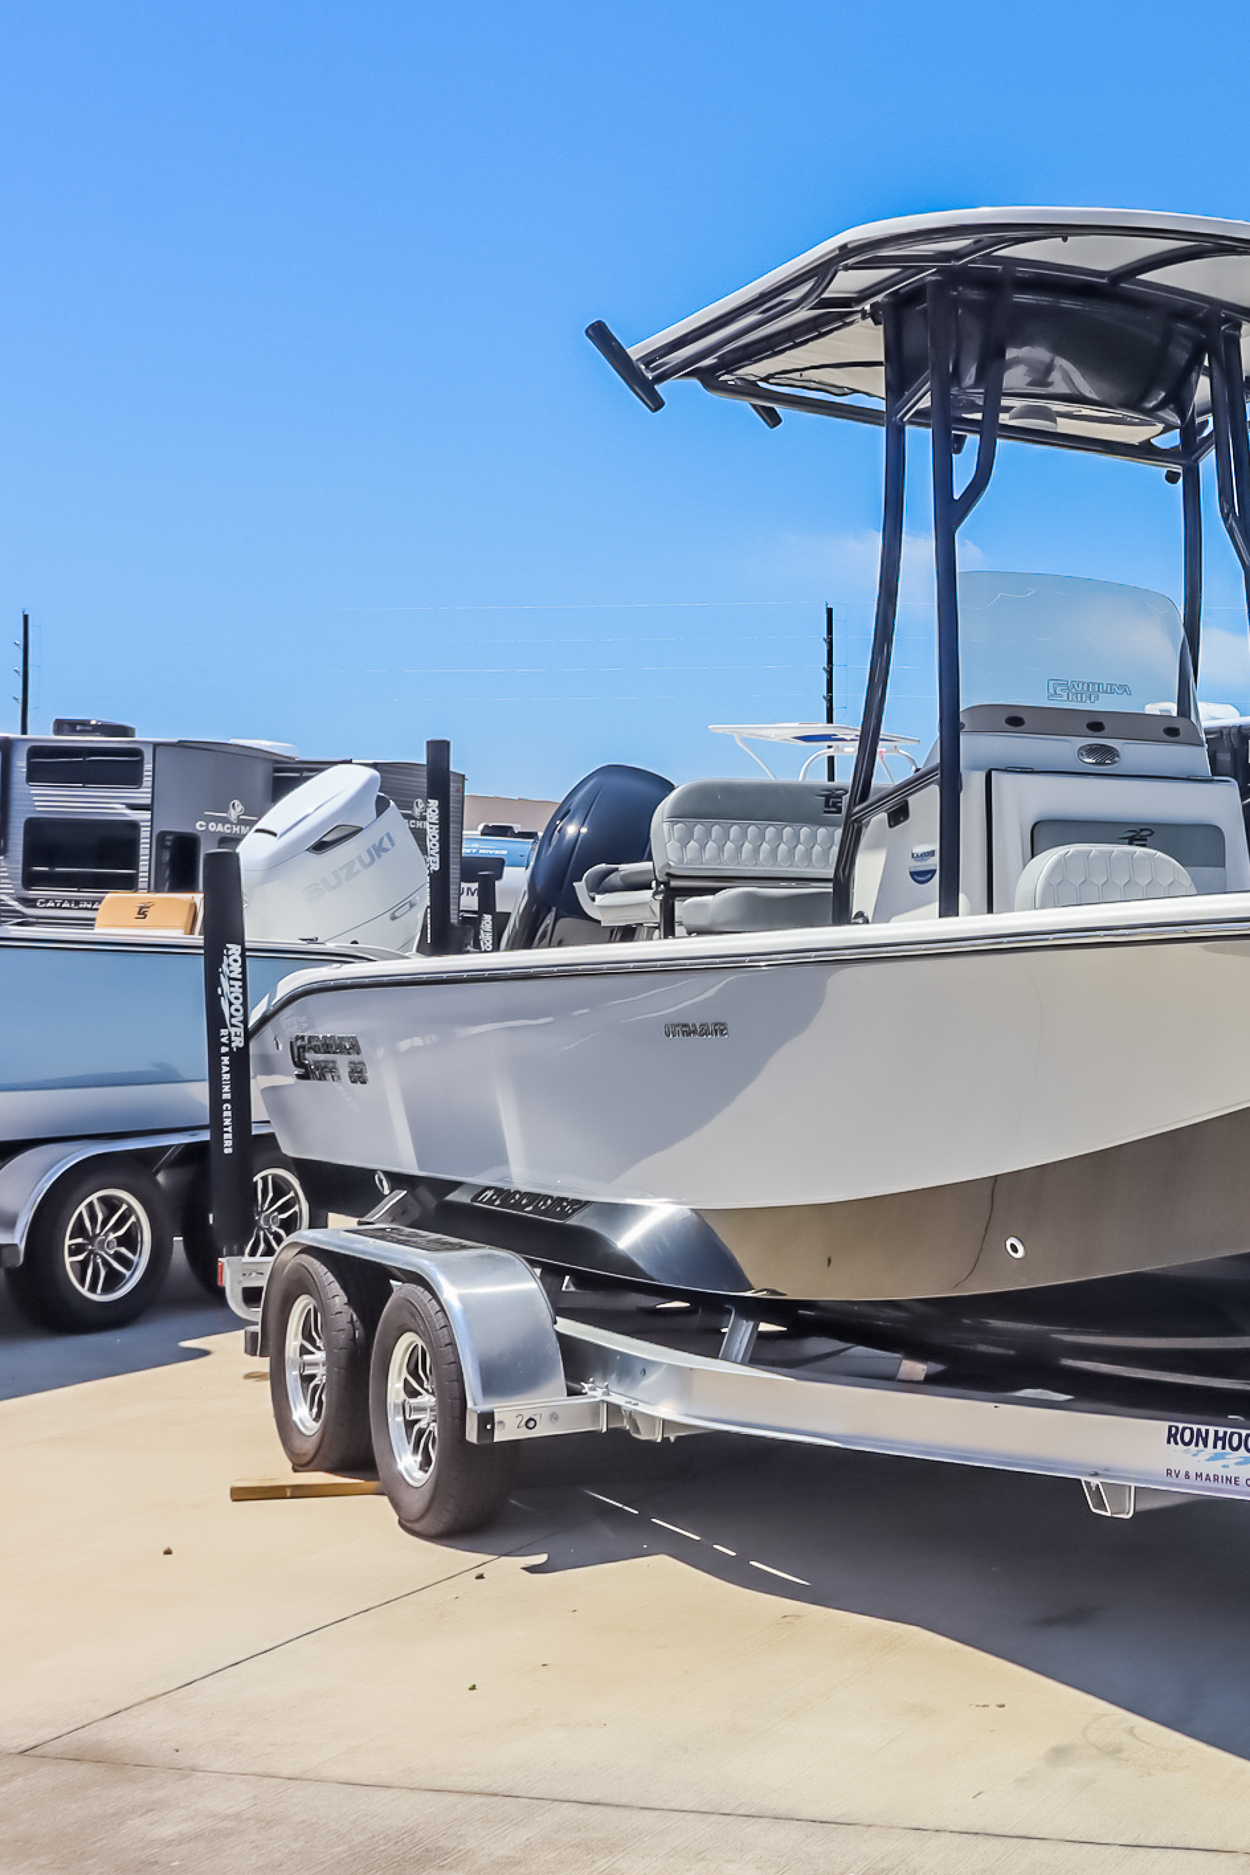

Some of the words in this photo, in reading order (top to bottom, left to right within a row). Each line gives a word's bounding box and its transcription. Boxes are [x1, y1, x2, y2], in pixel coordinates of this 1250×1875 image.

[427, 799, 440, 824] RON
[195, 820, 251, 835] COACHM
[429, 825, 441, 871] HOOVER
[302, 831, 396, 903] SUZUKI
[36, 898, 100, 910] CATALINA
[226, 944, 242, 979] RON
[229, 980, 245, 1048] HOOVER
[220, 1028, 230, 1044] RV
[220, 1046, 230, 1054] &
[221, 1056, 231, 1100] MARINE
[222, 1103, 233, 1154] CENTERS
[1166, 1424, 1210, 1449] RON
[1166, 1468, 1181, 1479] RV
[1184, 1470, 1190, 1480] &
[1195, 1472, 1241, 1487] MARINE
